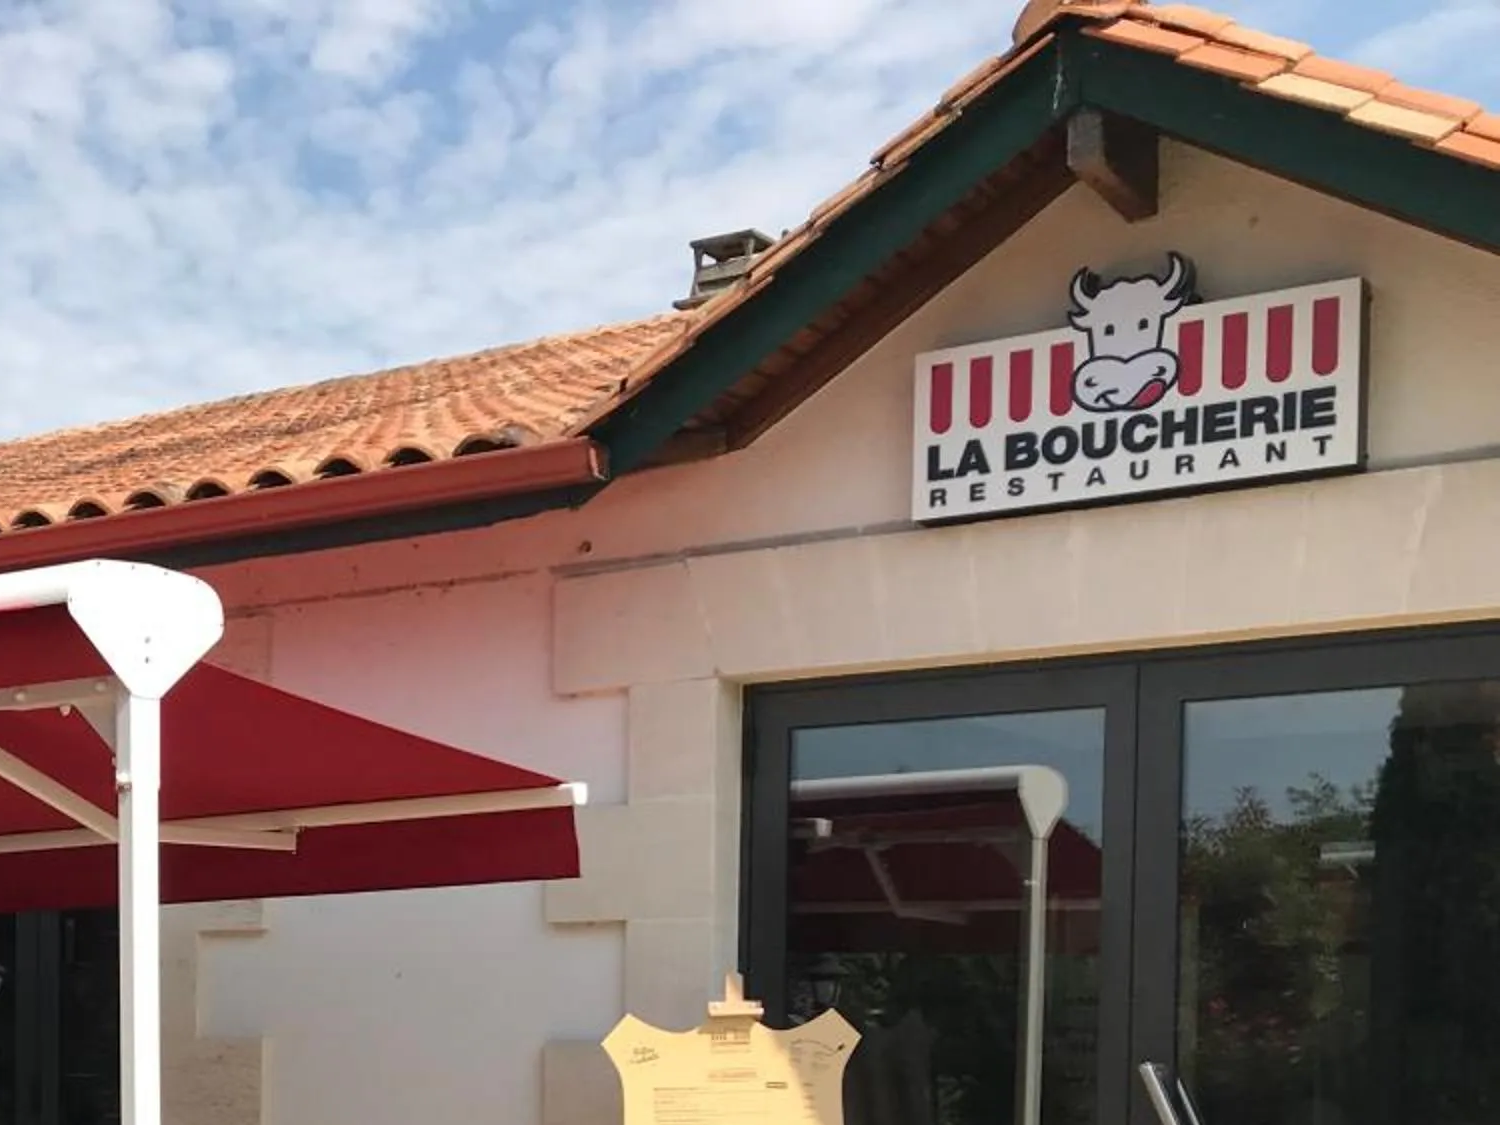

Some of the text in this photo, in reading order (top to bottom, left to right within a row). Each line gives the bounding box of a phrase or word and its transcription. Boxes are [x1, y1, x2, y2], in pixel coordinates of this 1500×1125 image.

[927, 385, 1337, 482] LA BOUCHERIE
[929, 434, 1333, 508] RESTAURANT
